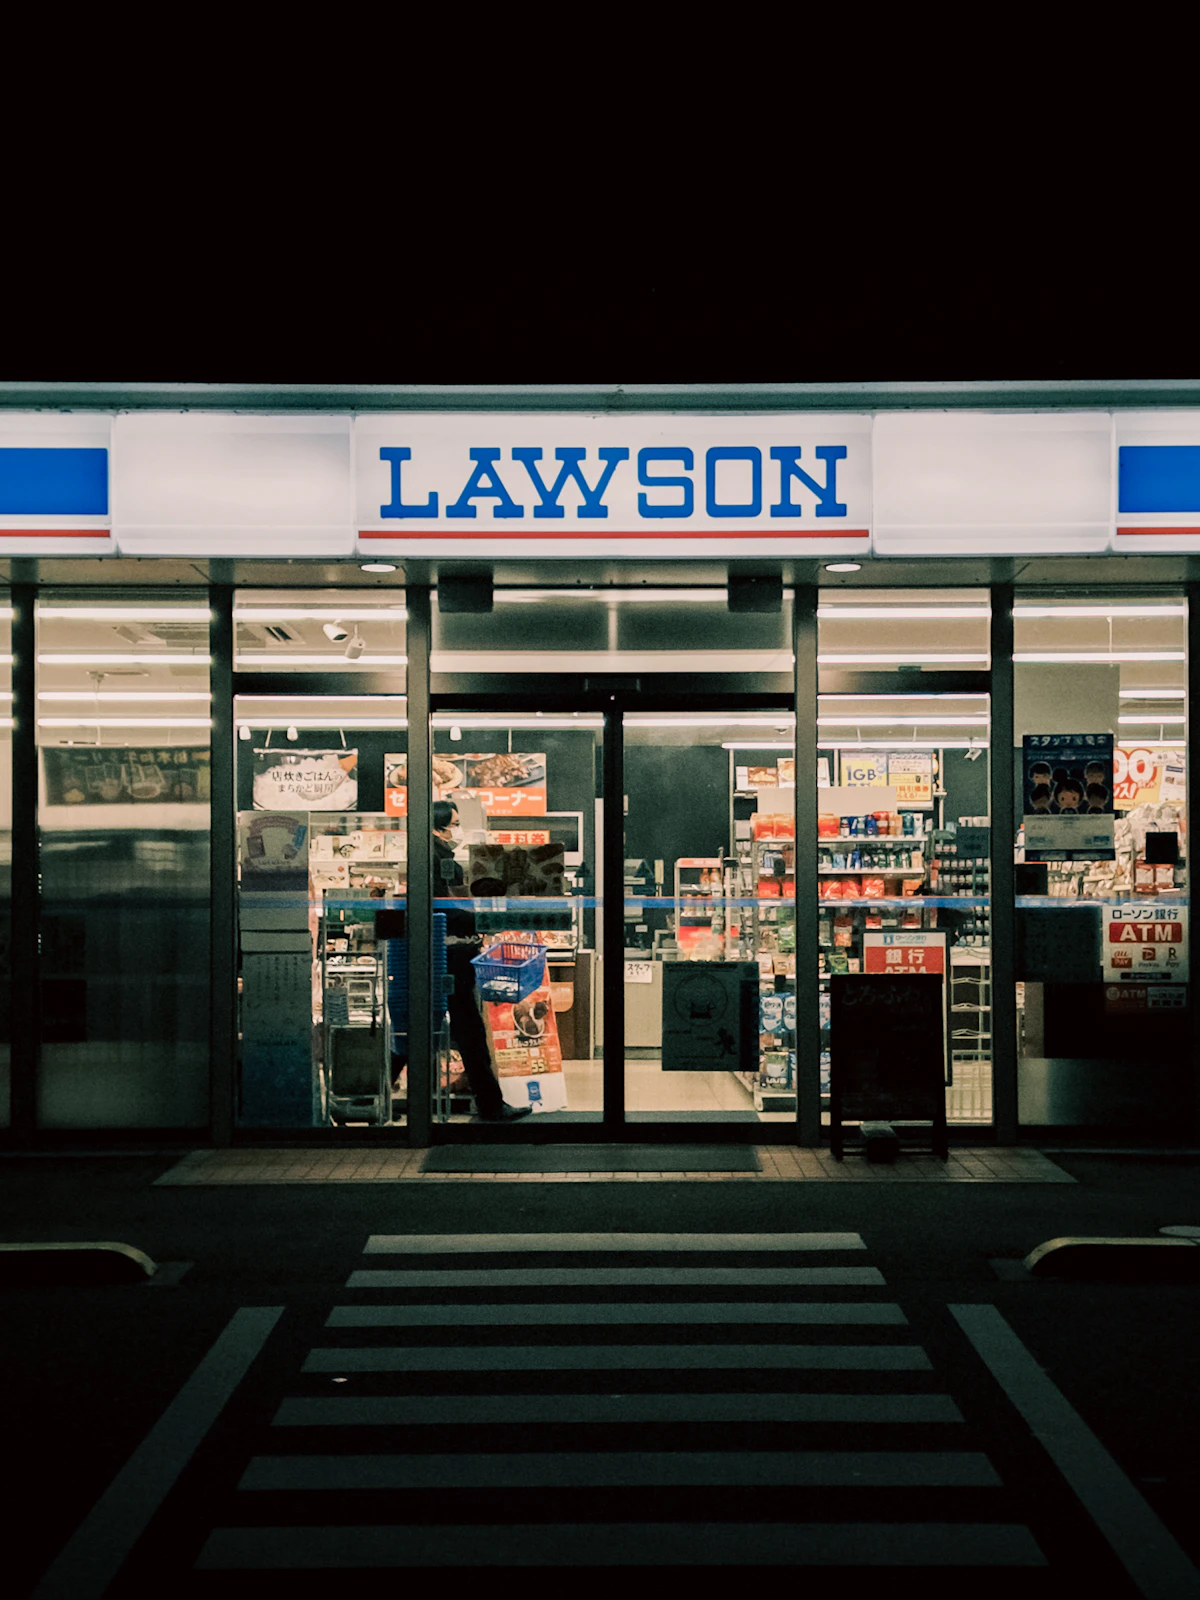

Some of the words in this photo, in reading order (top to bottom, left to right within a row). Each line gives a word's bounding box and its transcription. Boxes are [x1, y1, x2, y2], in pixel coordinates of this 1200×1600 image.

[379, 445, 848, 519] LAWSON
[1112, 908, 1179, 920] ローソン銀行
[1119, 923, 1174, 942] ATM
[885, 948, 925, 964] 銀行
